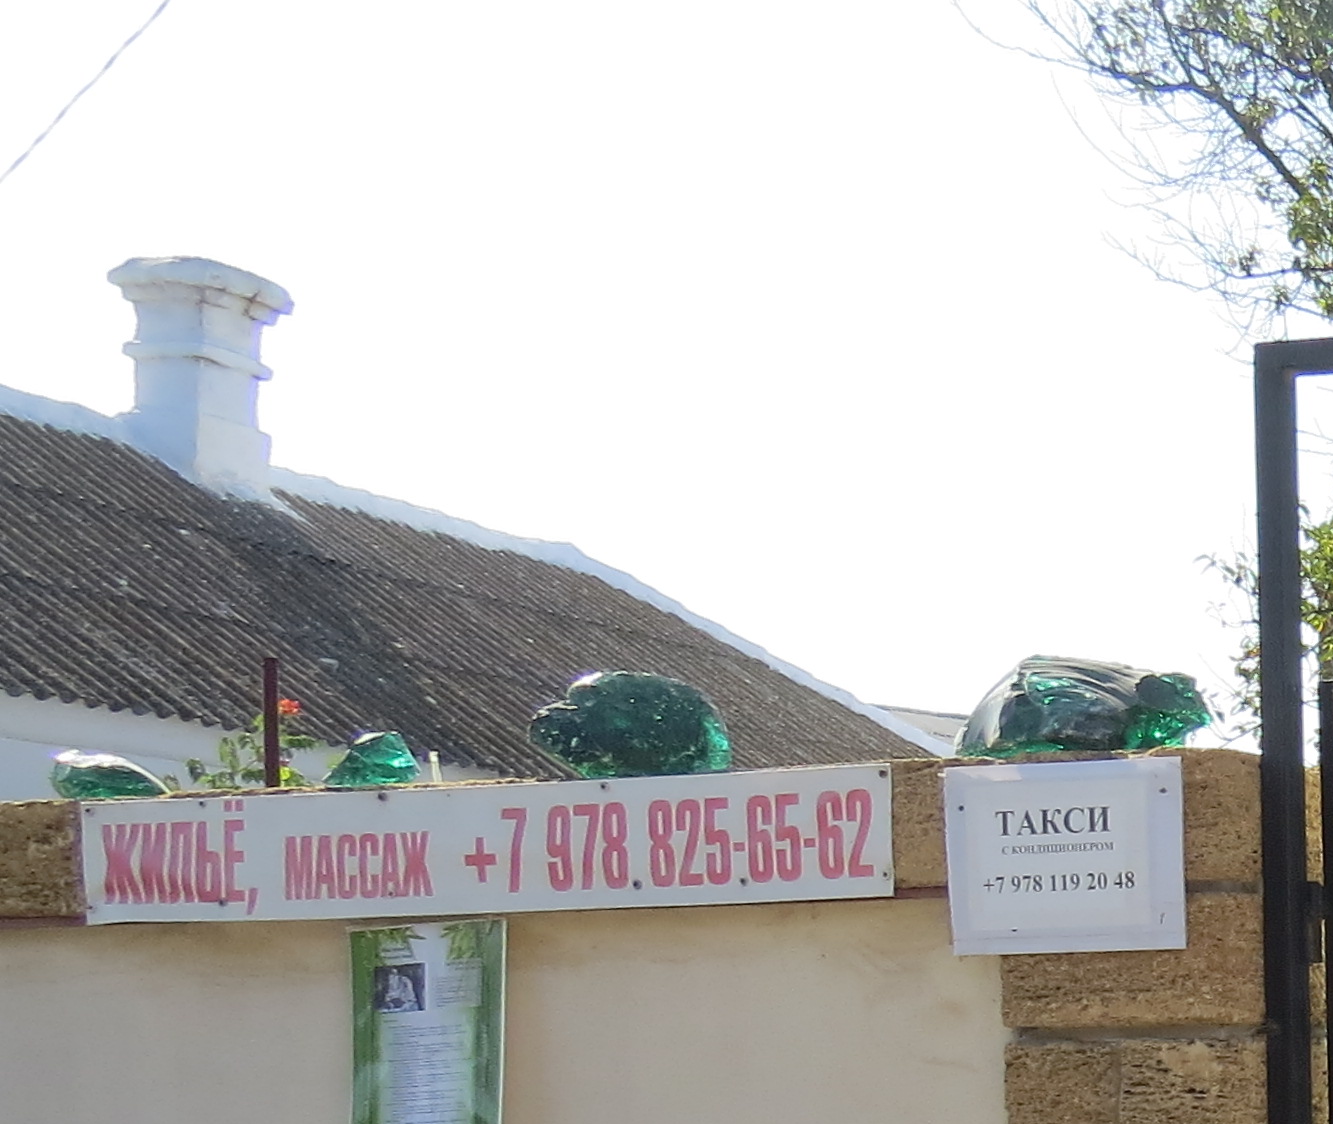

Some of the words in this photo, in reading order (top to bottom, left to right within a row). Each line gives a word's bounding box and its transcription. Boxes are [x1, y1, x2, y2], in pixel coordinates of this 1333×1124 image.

[995, 806, 1111, 836] ТАКСИ
[102, 800, 259, 916] ЖИЛЬЁ,
[284, 831, 434, 901] МАССАЖ
[464, 808, 527, 893] +7
[546, 801, 630, 892] 978
[648, 788, 875, 888] 825-65-62
[983, 876, 1005, 894] +7
[1011, 875, 1043, 892] 978
[1050, 873, 1080, 892] 119
[1087, 871, 1108, 890] 20
[1113, 871, 1136, 890] 48
